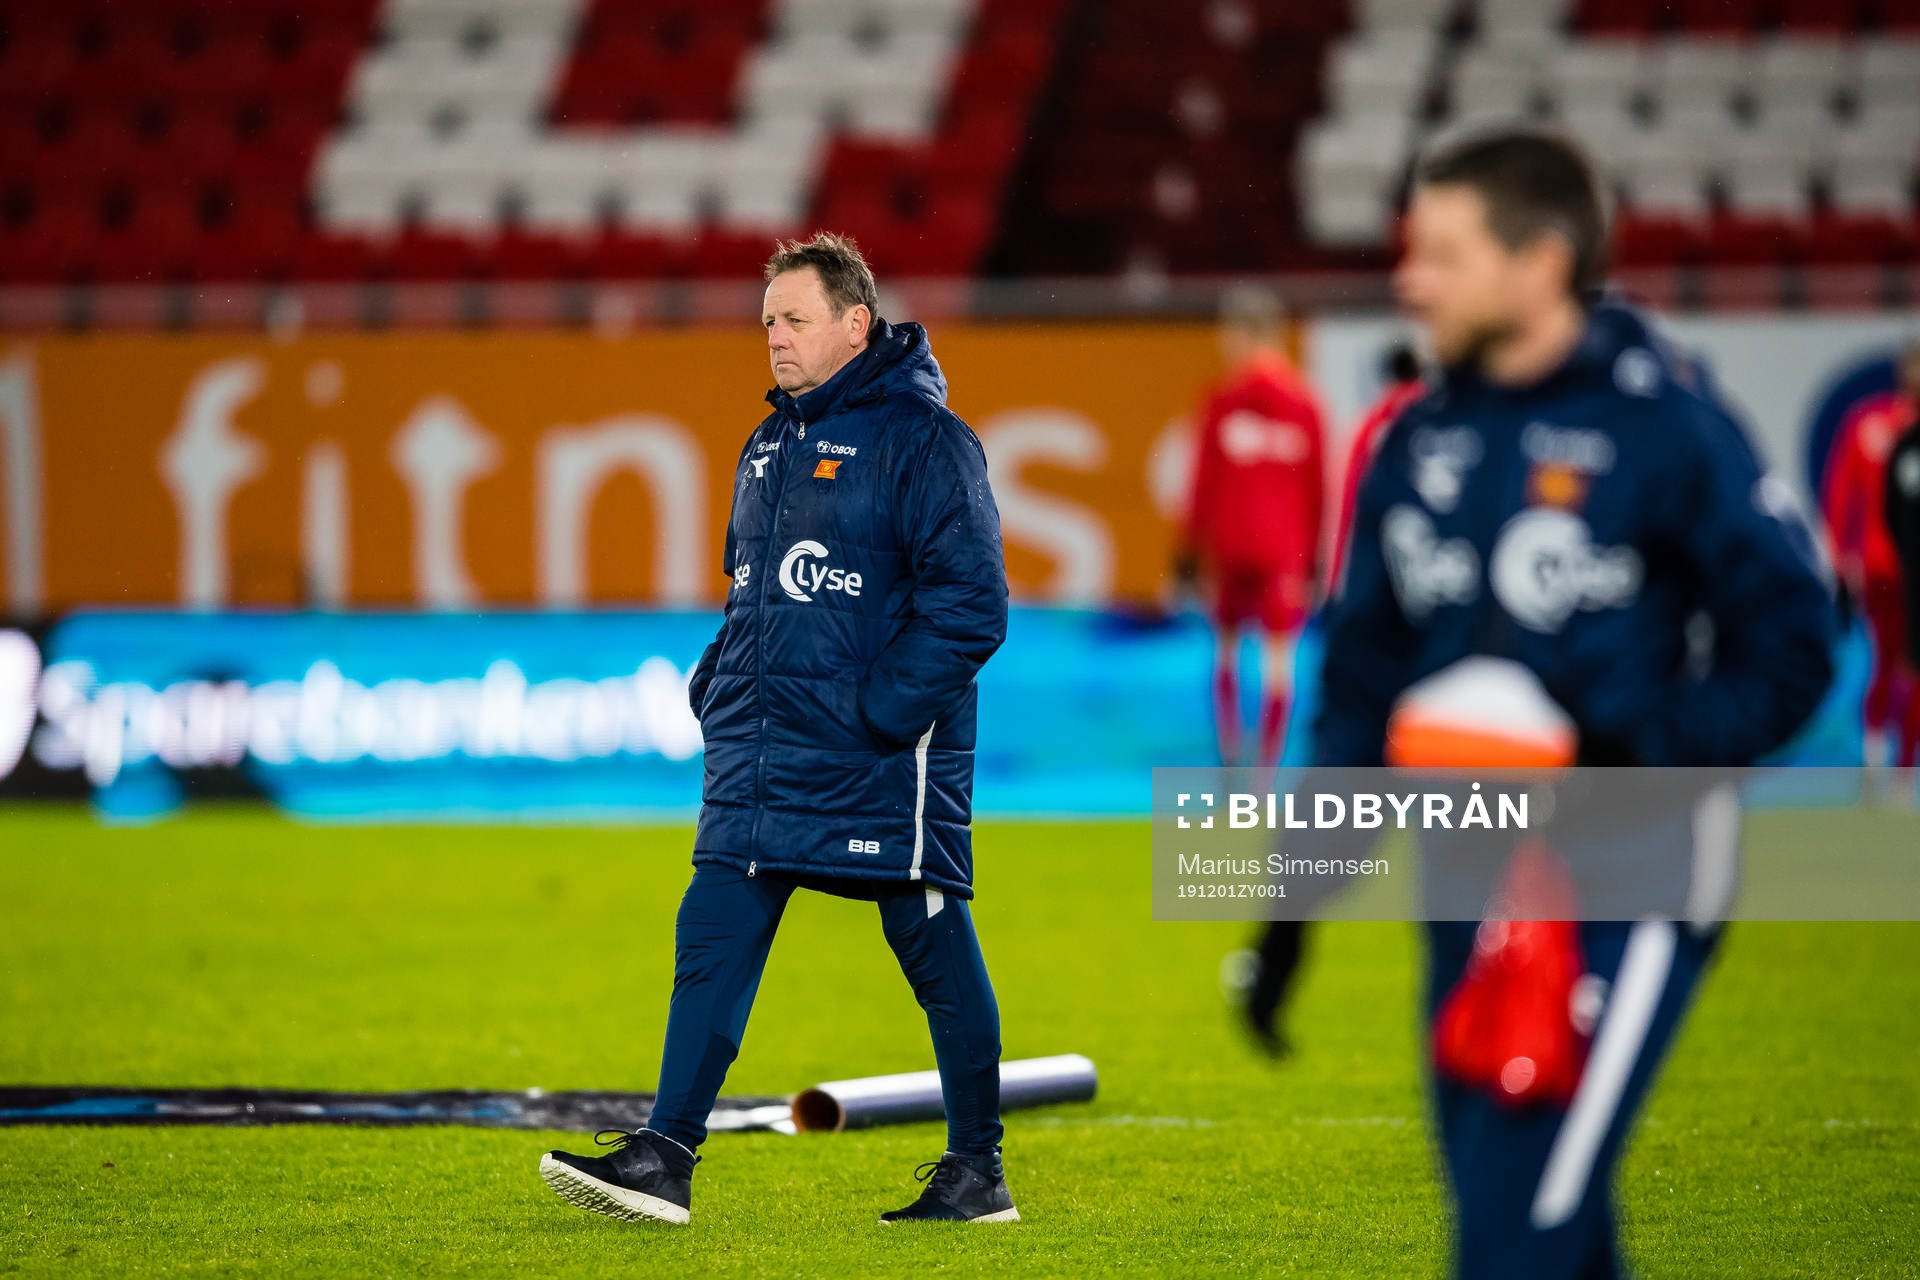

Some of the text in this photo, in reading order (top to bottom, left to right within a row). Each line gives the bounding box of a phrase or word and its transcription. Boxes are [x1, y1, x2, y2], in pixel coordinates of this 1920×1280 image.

[831, 444, 858, 457] OBOS
[158, 355, 1194, 608] fitns
[848, 838, 881, 855] BB
